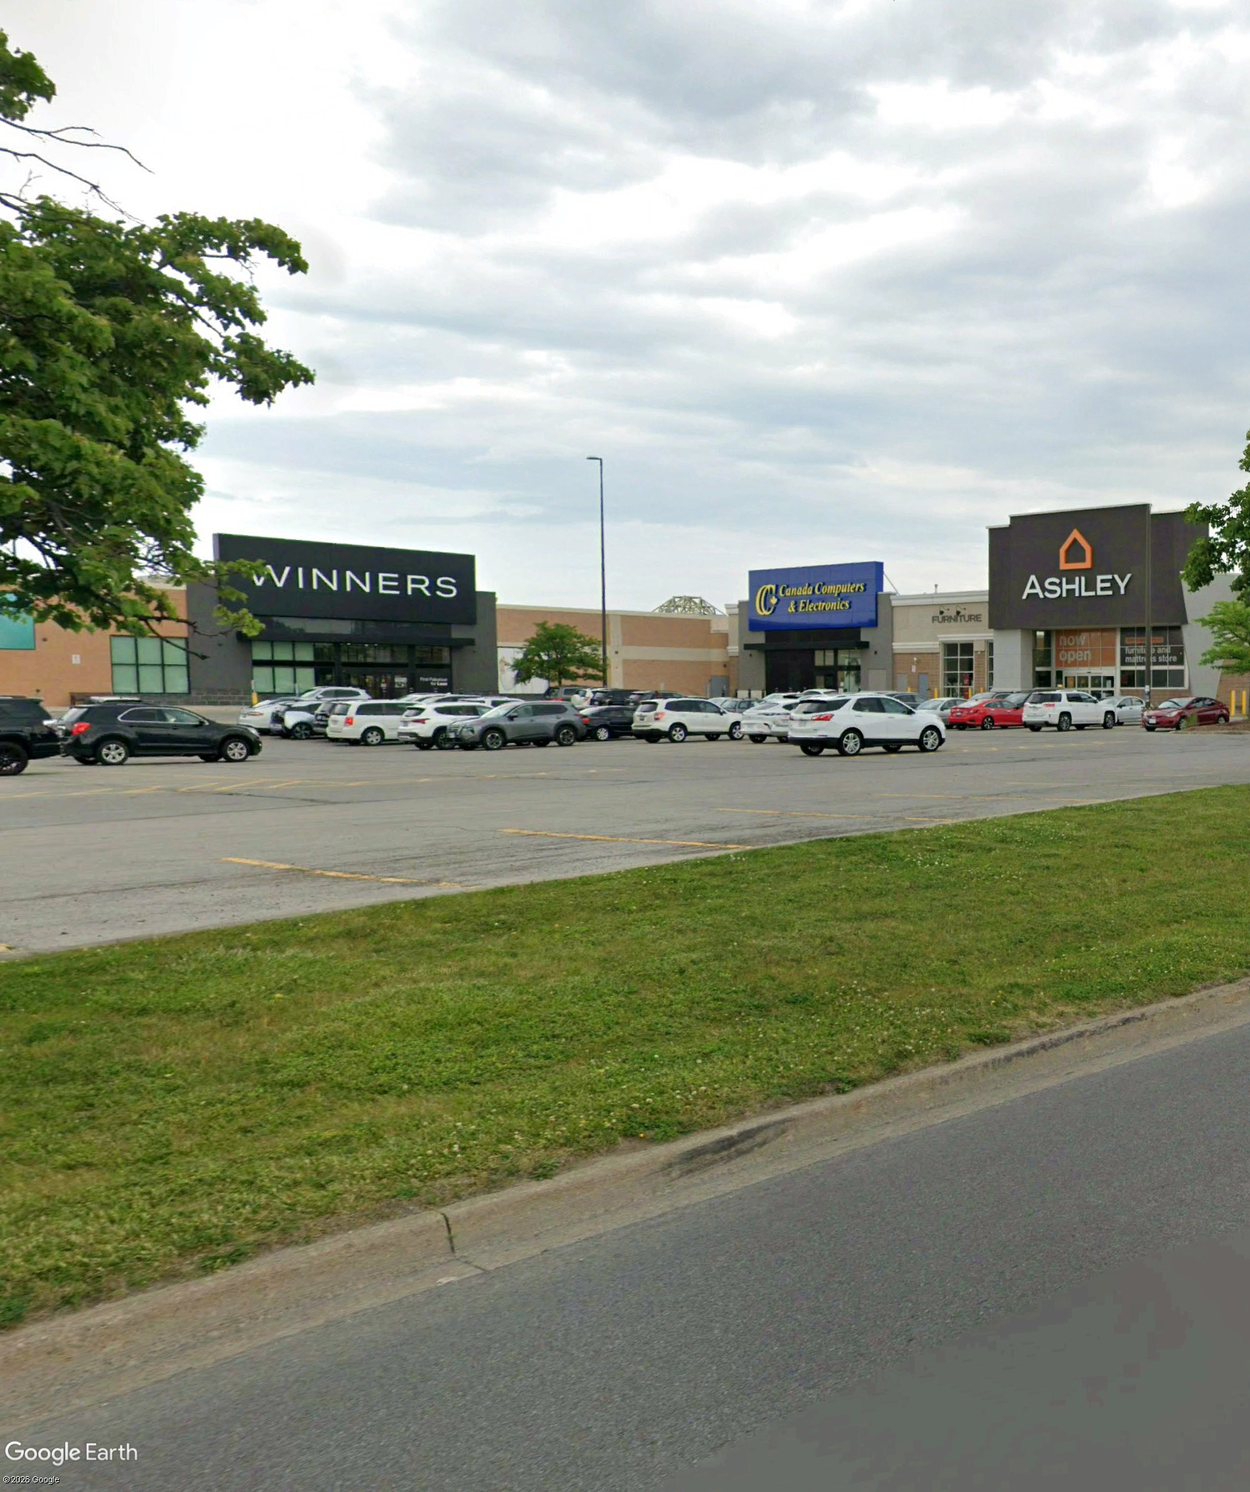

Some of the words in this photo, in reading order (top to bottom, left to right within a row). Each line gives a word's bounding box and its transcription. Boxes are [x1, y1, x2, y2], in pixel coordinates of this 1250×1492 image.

[252, 565, 458, 598] WINNERS
[1021, 573, 1132, 600] ASHLEY
[779, 583, 813, 597] Canada
[814, 581, 865, 596] Computers
[787, 600, 797, 613] &
[798, 598, 850, 612] Electronics
[931, 614, 982, 623] FURNITURE
[1060, 634, 1087, 646] now
[1060, 649, 1092, 663] open
[1157, 646, 1171, 654] and
[1158, 654, 1177, 663] store
